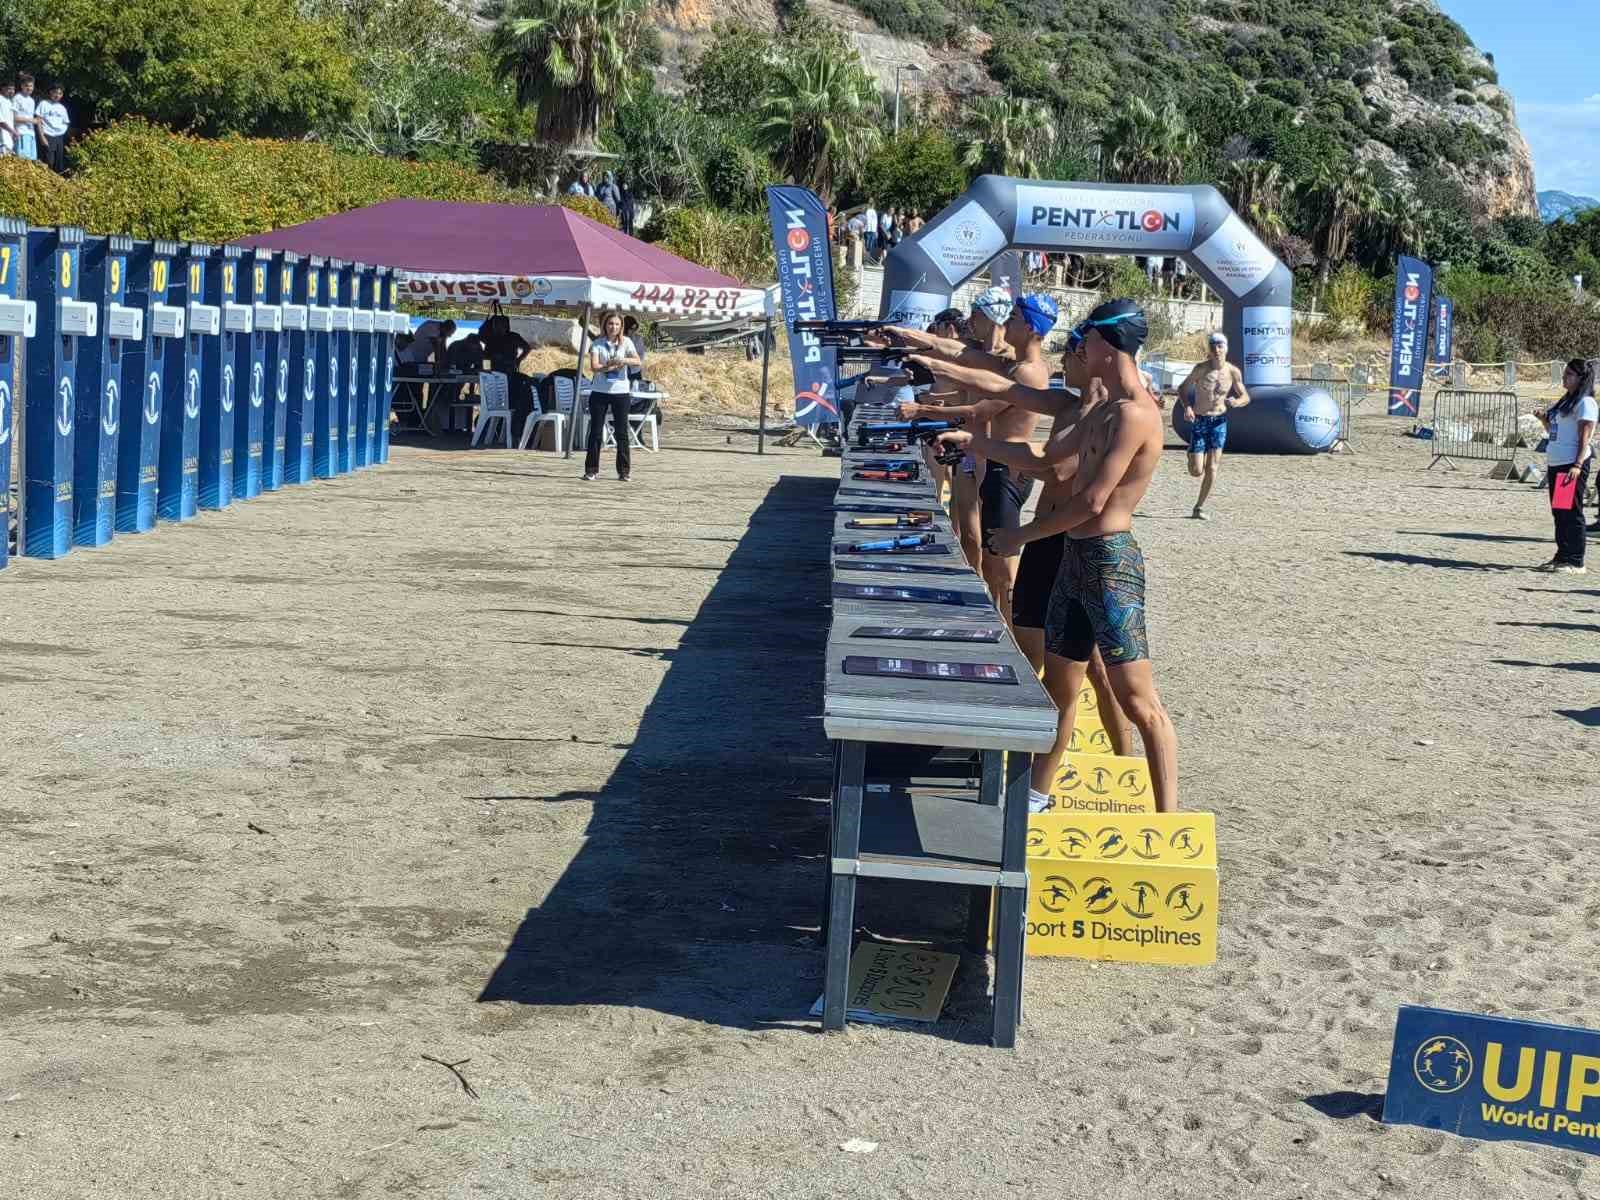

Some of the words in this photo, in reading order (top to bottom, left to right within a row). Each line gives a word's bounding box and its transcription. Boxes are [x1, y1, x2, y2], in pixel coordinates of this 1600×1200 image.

[0, 247, 10, 284] 7
[61, 251, 71, 288] 8
[111, 259, 120, 294] 9
[153, 260, 167, 292] 10
[190, 263, 200, 294] 11
[223, 264, 234, 294] 12
[255, 267, 264, 294] 13
[397, 275, 507, 297] EDİYESİ
[631, 284, 675, 305] 444
[681, 288, 710, 308] 82
[1061, 795, 1145, 813] Disciplines
[1025, 920, 1067, 938] port
[1072, 920, 1085, 939] 5
[1091, 921, 1201, 946] Disciplines
[1482, 1041, 1600, 1113] UIP
[1481, 1102, 1550, 1131] World
[1553, 1114, 1600, 1139] Pent
